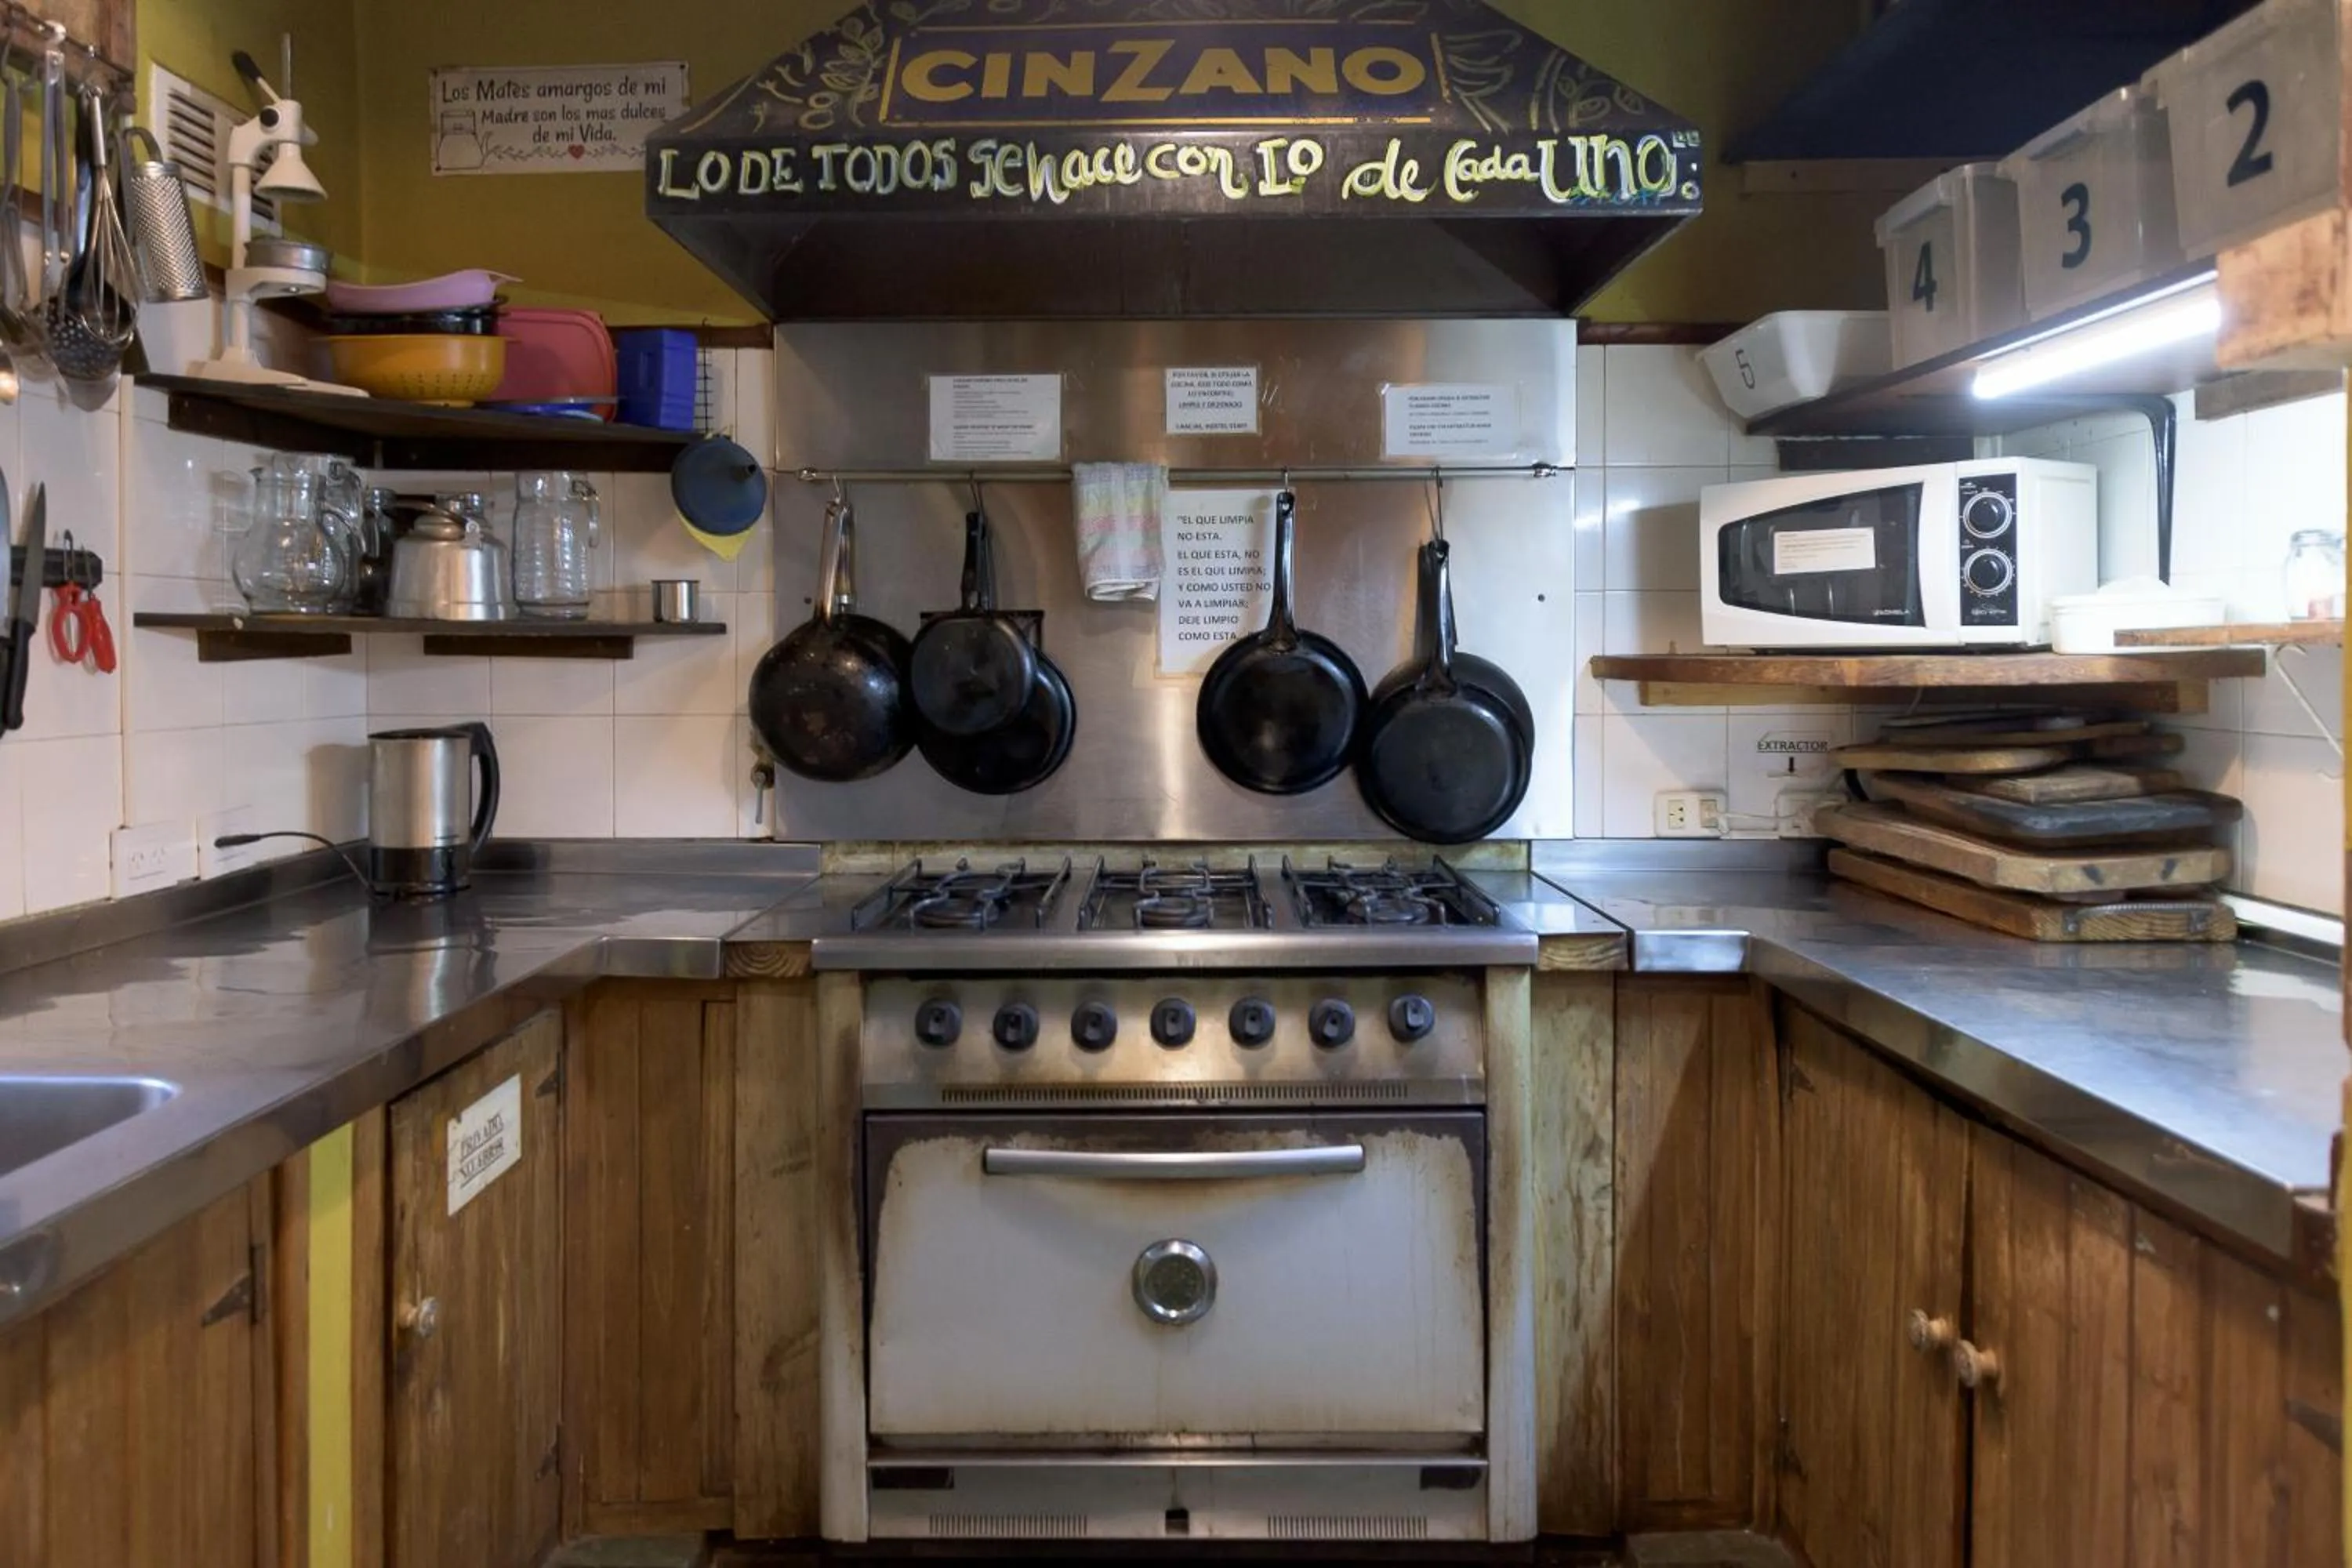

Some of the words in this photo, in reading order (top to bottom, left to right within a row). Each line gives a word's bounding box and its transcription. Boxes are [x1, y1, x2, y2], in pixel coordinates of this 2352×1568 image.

[902, 39, 1425, 102] CINZANO
[442, 81, 469, 103] Los
[476, 80, 531, 101] Mates
[537, 79, 612, 102] amargos
[619, 76, 637, 95] de
[644, 77, 666, 95] mi
[481, 108, 528, 124] Madre
[532, 109, 557, 122] son
[562, 104, 581, 121] los
[621, 103, 665, 119] dulces
[532, 125, 550, 143] de
[555, 126, 574, 142] mi
[579, 123, 617, 142] Vida.
[2226, 79, 2273, 187] 2
[657, 148, 731, 201] LO
[737, 148, 804, 195] DE
[811, 137, 958, 195] TODOS
[1341, 138, 1439, 202] de
[2060, 182, 2092, 270] 3
[1913, 240, 1937, 313] 4
[1735, 349, 1756, 390] 5
[1196, 515, 1216, 525] QUE
[1219, 515, 1254, 524] LIMPIA
[1178, 550, 1189, 559] EL
[1191, 550, 1211, 559] QUE
[1214, 550, 1242, 560] ESTA,
[1244, 550, 1260, 559] NO
[1178, 567, 1189, 575] ES
[1192, 567, 1203, 575] EL
[1205, 567, 1225, 576] QUE
[1186, 583, 1218, 592] COMO
[1221, 583, 1254, 592] USTED
[1255, 583, 1272, 592] NO
[1178, 600, 1193, 608] VA
[1178, 615, 1202, 625] DEJE
[1203, 615, 1239, 624] LIMPIO
[1178, 632, 1210, 641] COMO
[1757, 741, 1828, 752] EXTRACTOR
